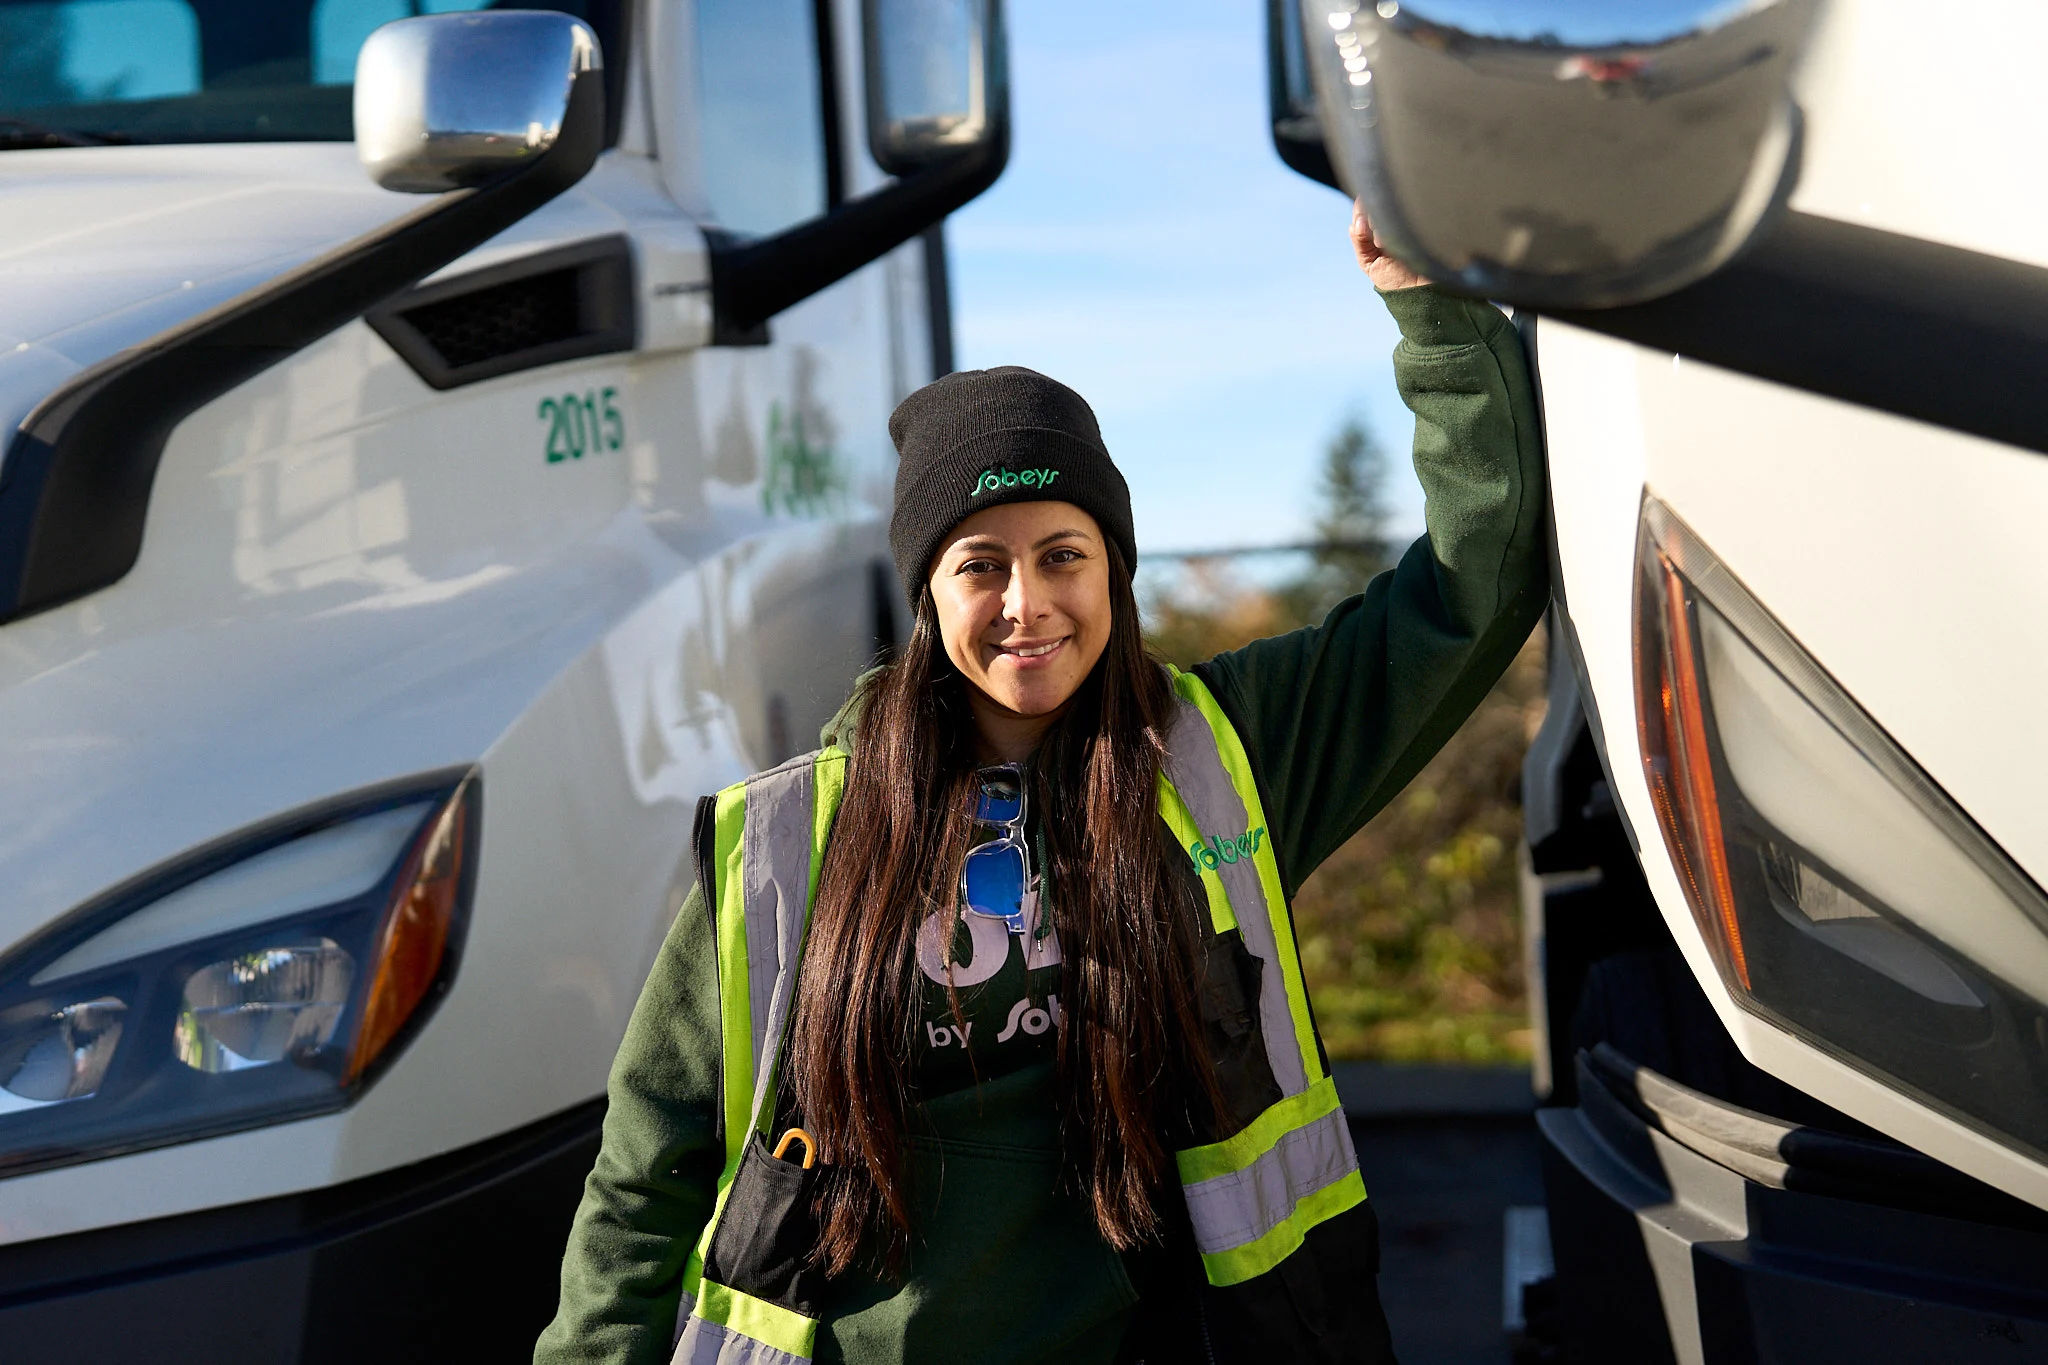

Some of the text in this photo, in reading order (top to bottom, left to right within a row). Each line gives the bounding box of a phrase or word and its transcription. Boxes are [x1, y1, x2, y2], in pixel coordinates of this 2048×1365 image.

[538, 386, 625, 465] 2015
[970, 466, 1060, 497] Sobeys
[925, 1021, 973, 1049] by
